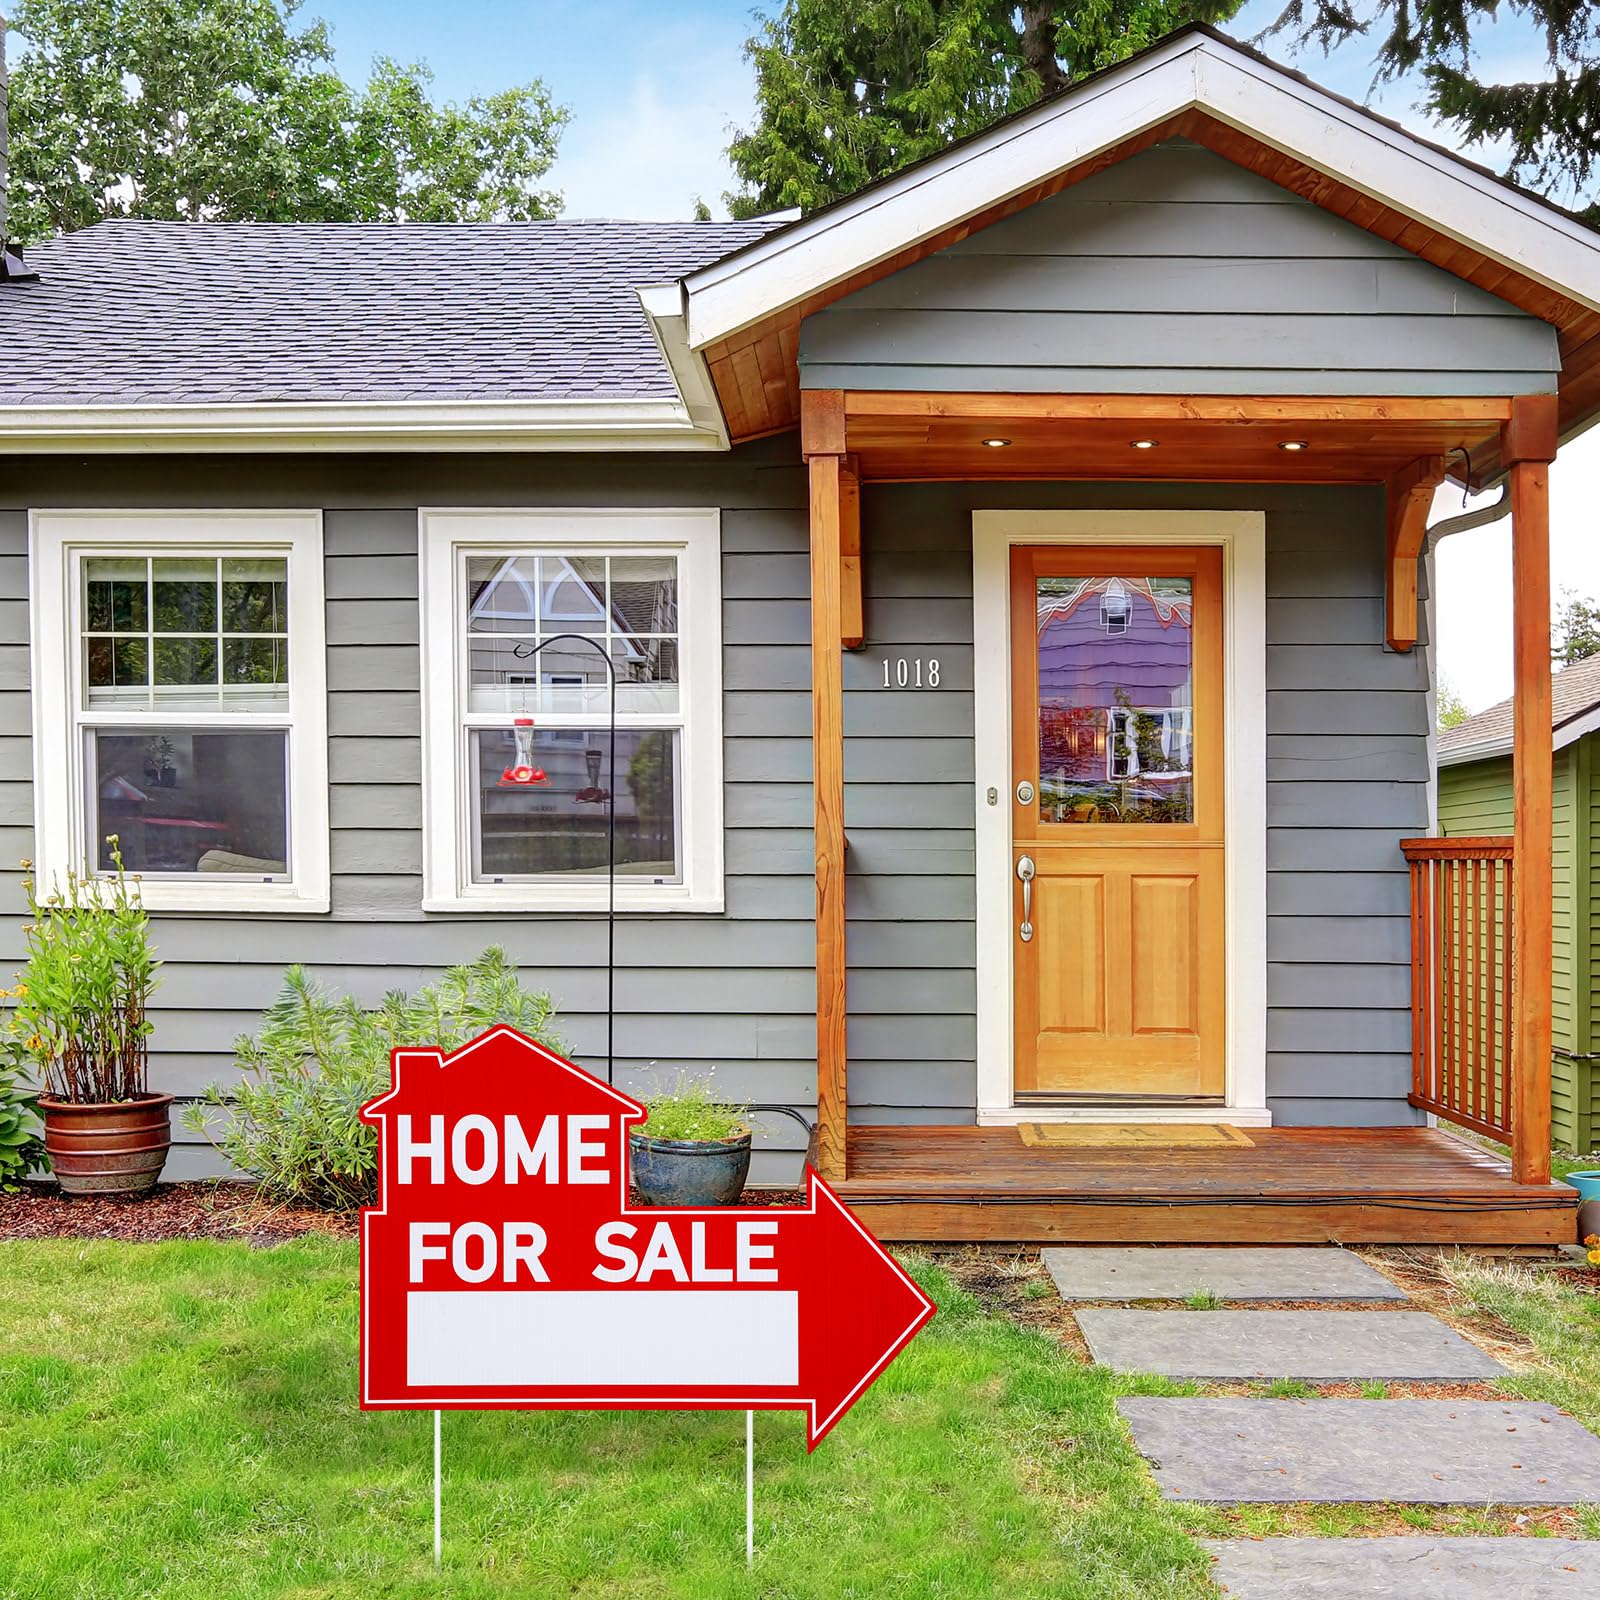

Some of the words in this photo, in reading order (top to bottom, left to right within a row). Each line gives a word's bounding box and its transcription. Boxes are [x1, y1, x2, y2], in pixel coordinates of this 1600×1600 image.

[882, 658, 940, 687] 1018
[397, 1114, 611, 1185] HOME
[409, 1221, 551, 1283] FOR
[592, 1221, 779, 1283] SALE
